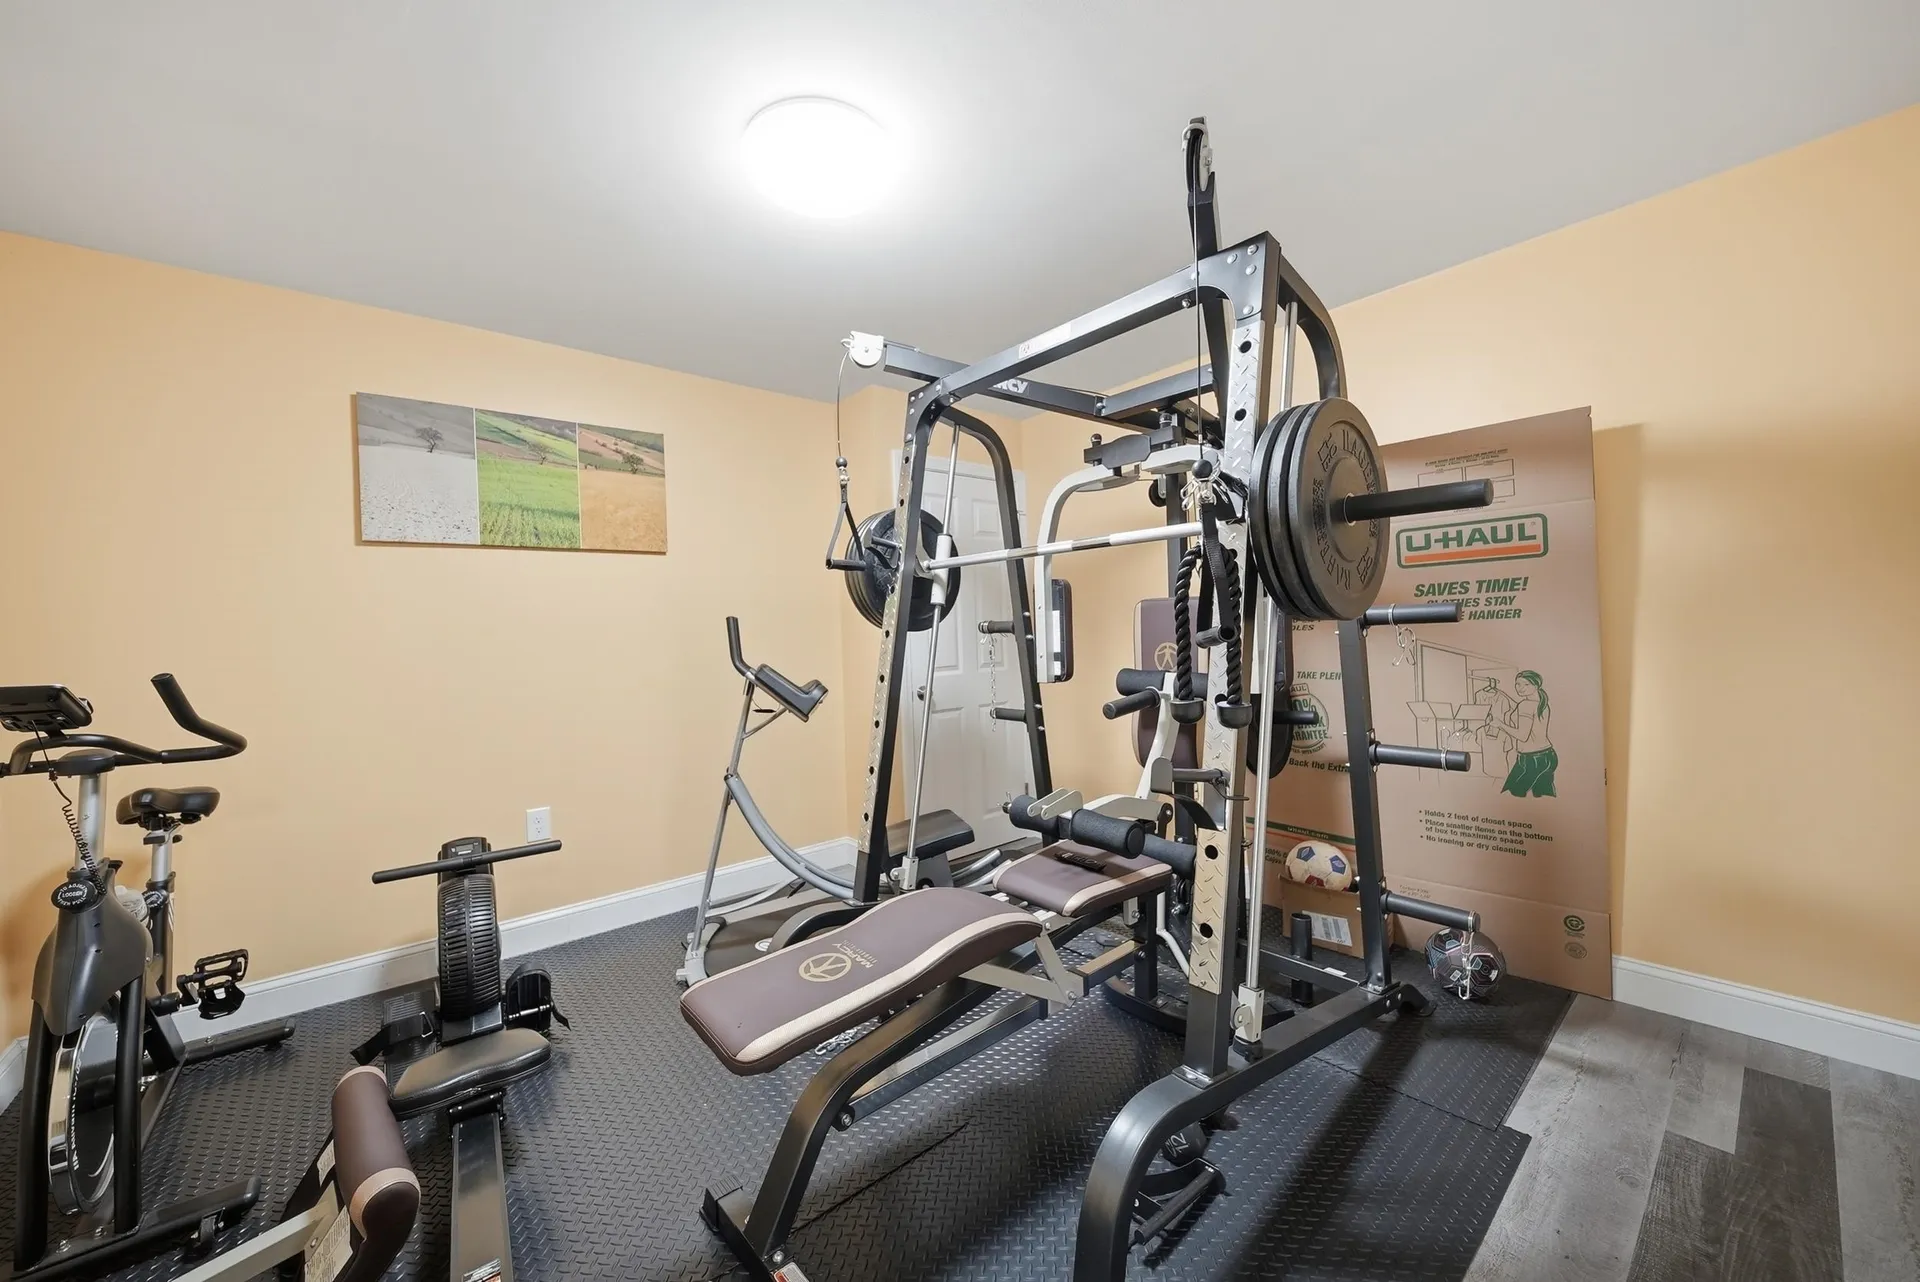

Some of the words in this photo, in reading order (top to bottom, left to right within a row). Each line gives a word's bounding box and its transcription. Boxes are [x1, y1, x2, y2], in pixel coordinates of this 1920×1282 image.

[1405, 522, 1537, 552] U-HAUL
[1414, 581, 1471, 598] SAVES
[1475, 576, 1529, 594] TIME!
[1484, 595, 1516, 608] STAY
[1468, 608, 1522, 621] HANGER
[1297, 671, 1318, 680] TAKE
[1288, 757, 1309, 768] Back
[1311, 759, 1326, 770] the
[1424, 809, 1445, 818] Holds
[1454, 813, 1469, 821] feet
[1471, 815, 1479, 823] of
[1481, 817, 1506, 826] closet
[1507, 820, 1533, 830] space
[1425, 818, 1445, 828] Place
[1446, 821, 1474, 831] smaller
[1474, 825, 1496, 834] items
[1509, 830, 1522, 838] the
[1524, 832, 1553, 842] bottom
[1426, 834, 1436, 842] No
[1438, 836, 1465, 848] ironing
[1476, 842, 1490, 852] dry
[1491, 844, 1527, 856] cleaning
[1434, 827, 1448, 835] box
[1450, 829, 1458, 837] to
[1460, 831, 1497, 842] maximize
[1499, 837, 1525, 846] space
[832, 942, 874, 969] MARCY
